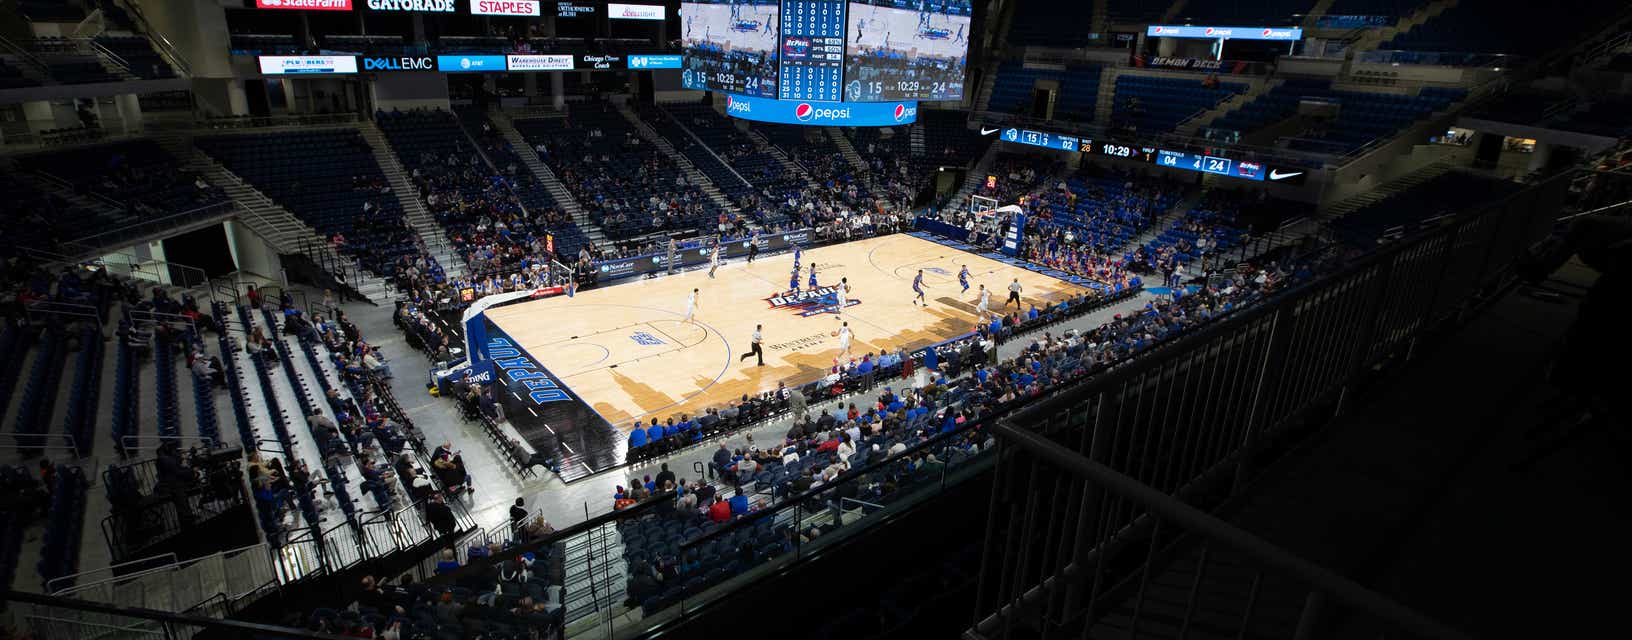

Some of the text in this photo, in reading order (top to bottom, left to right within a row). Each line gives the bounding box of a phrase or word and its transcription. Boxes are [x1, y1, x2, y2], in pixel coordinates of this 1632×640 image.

[367, 0, 455, 12] GATORADE
[480, 1, 533, 13] STAPLES
[1151, 57, 1223, 70] DEMON DECK
[696, 71, 707, 83] 15
[716, 73, 735, 84] 10:29
[745, 76, 759, 89] 24
[868, 82, 882, 94] 15
[898, 81, 920, 92] 10:29
[931, 81, 946, 94] 24
[732, 101, 751, 112] pepsi
[814, 107, 850, 120] pepsi
[1027, 134, 1037, 143] 15
[1042, 137, 1048, 146] 3
[1062, 141, 1073, 150] 02
[1081, 144, 1091, 152] 28
[1103, 144, 1130, 157] 10:29
[1164, 156, 1176, 166] 04
[1194, 160, 1201, 169] 4
[1209, 160, 1224, 171] 24
[769, 333, 826, 350] WINTRUST
[487, 338, 574, 406] DEPAUL
